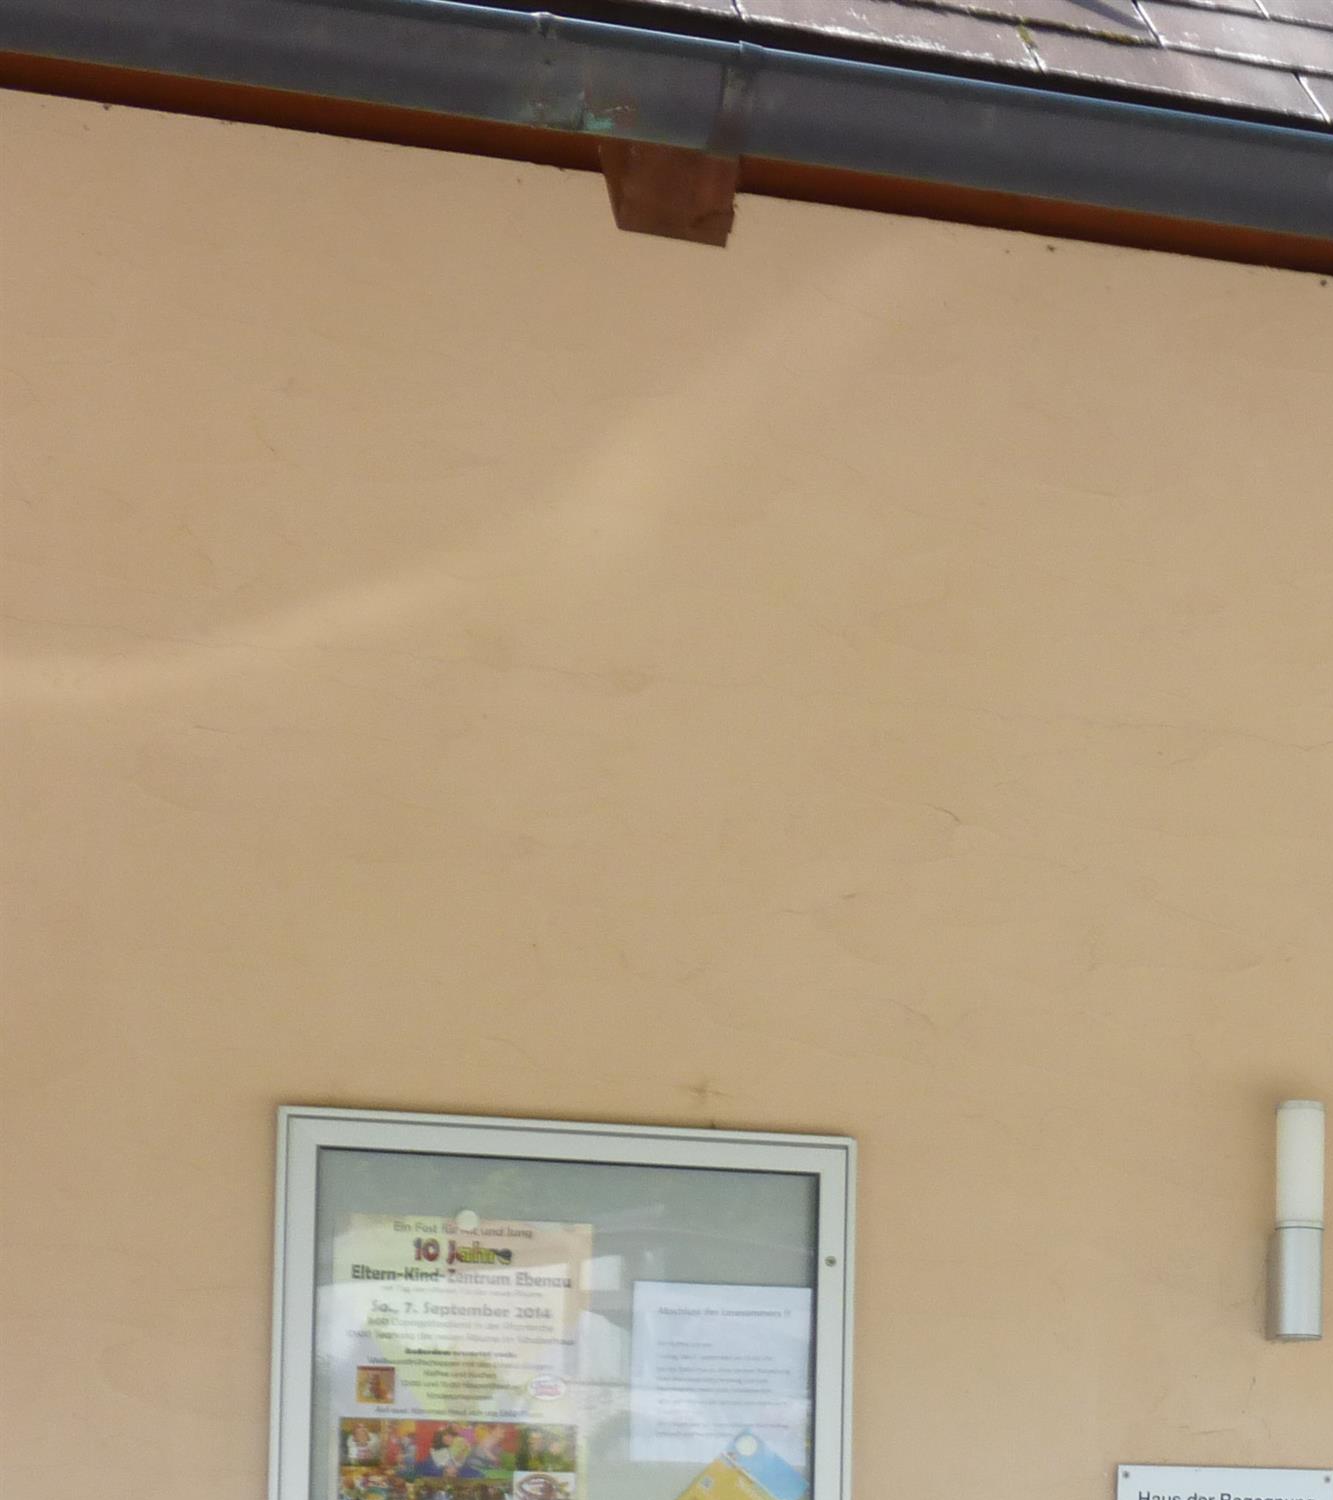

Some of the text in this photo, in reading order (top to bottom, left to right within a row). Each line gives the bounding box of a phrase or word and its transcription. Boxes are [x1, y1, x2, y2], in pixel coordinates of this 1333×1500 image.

[414, 1237, 513, 1265] 10 Jahre
[515, 1271, 572, 1288] Ebenau
[424, 1302, 509, 1318] September
